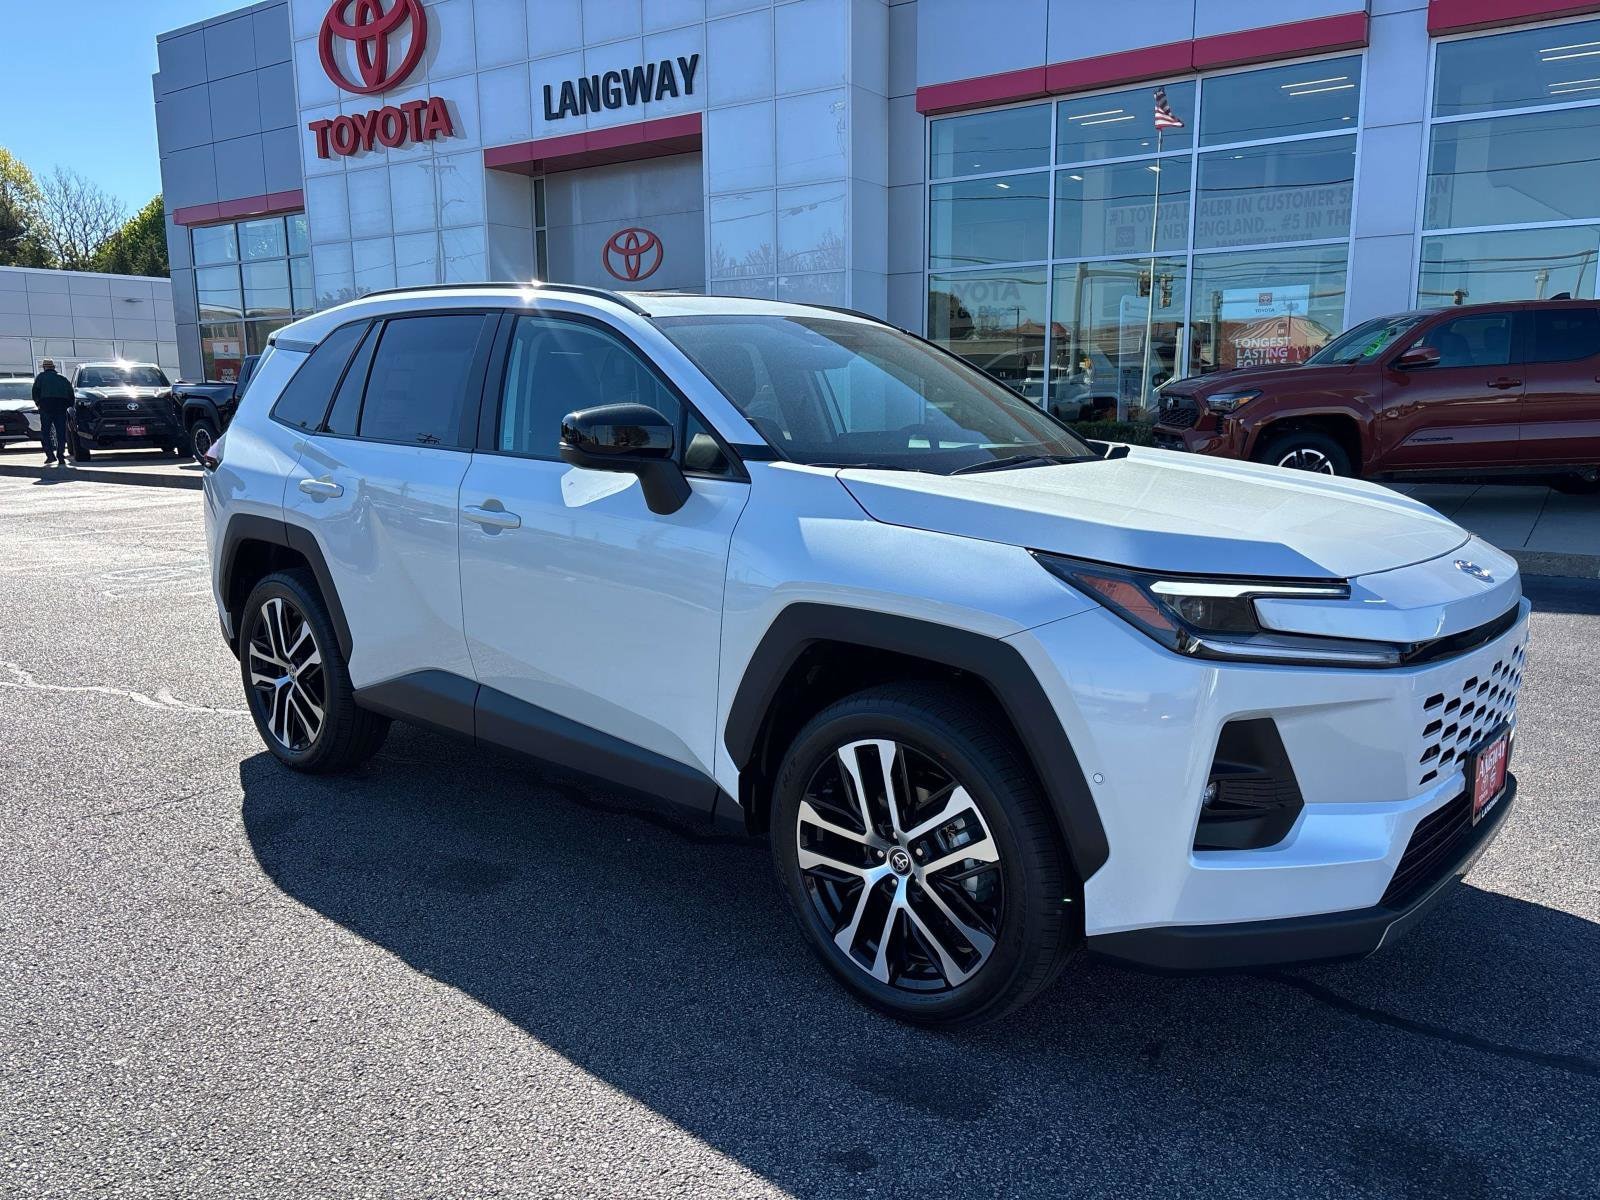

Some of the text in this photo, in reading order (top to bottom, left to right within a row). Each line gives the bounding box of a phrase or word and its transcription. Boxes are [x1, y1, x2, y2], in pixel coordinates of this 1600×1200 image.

[543, 54, 700, 121] LANGWAY
[309, 96, 454, 159] TOYOTA
[1109, 208, 1124, 225] #1
[1129, 204, 1179, 223] TOYOTA
[1184, 199, 1232, 217] DALER
[1236, 198, 1252, 213] IN
[1257, 188, 1334, 212] CUSTOMER
[1281, 213, 1300, 230] #5
[1305, 210, 1322, 228] IN
[1235, 336, 1291, 348] LONGEST
[1236, 347, 1288, 359] LASTING
